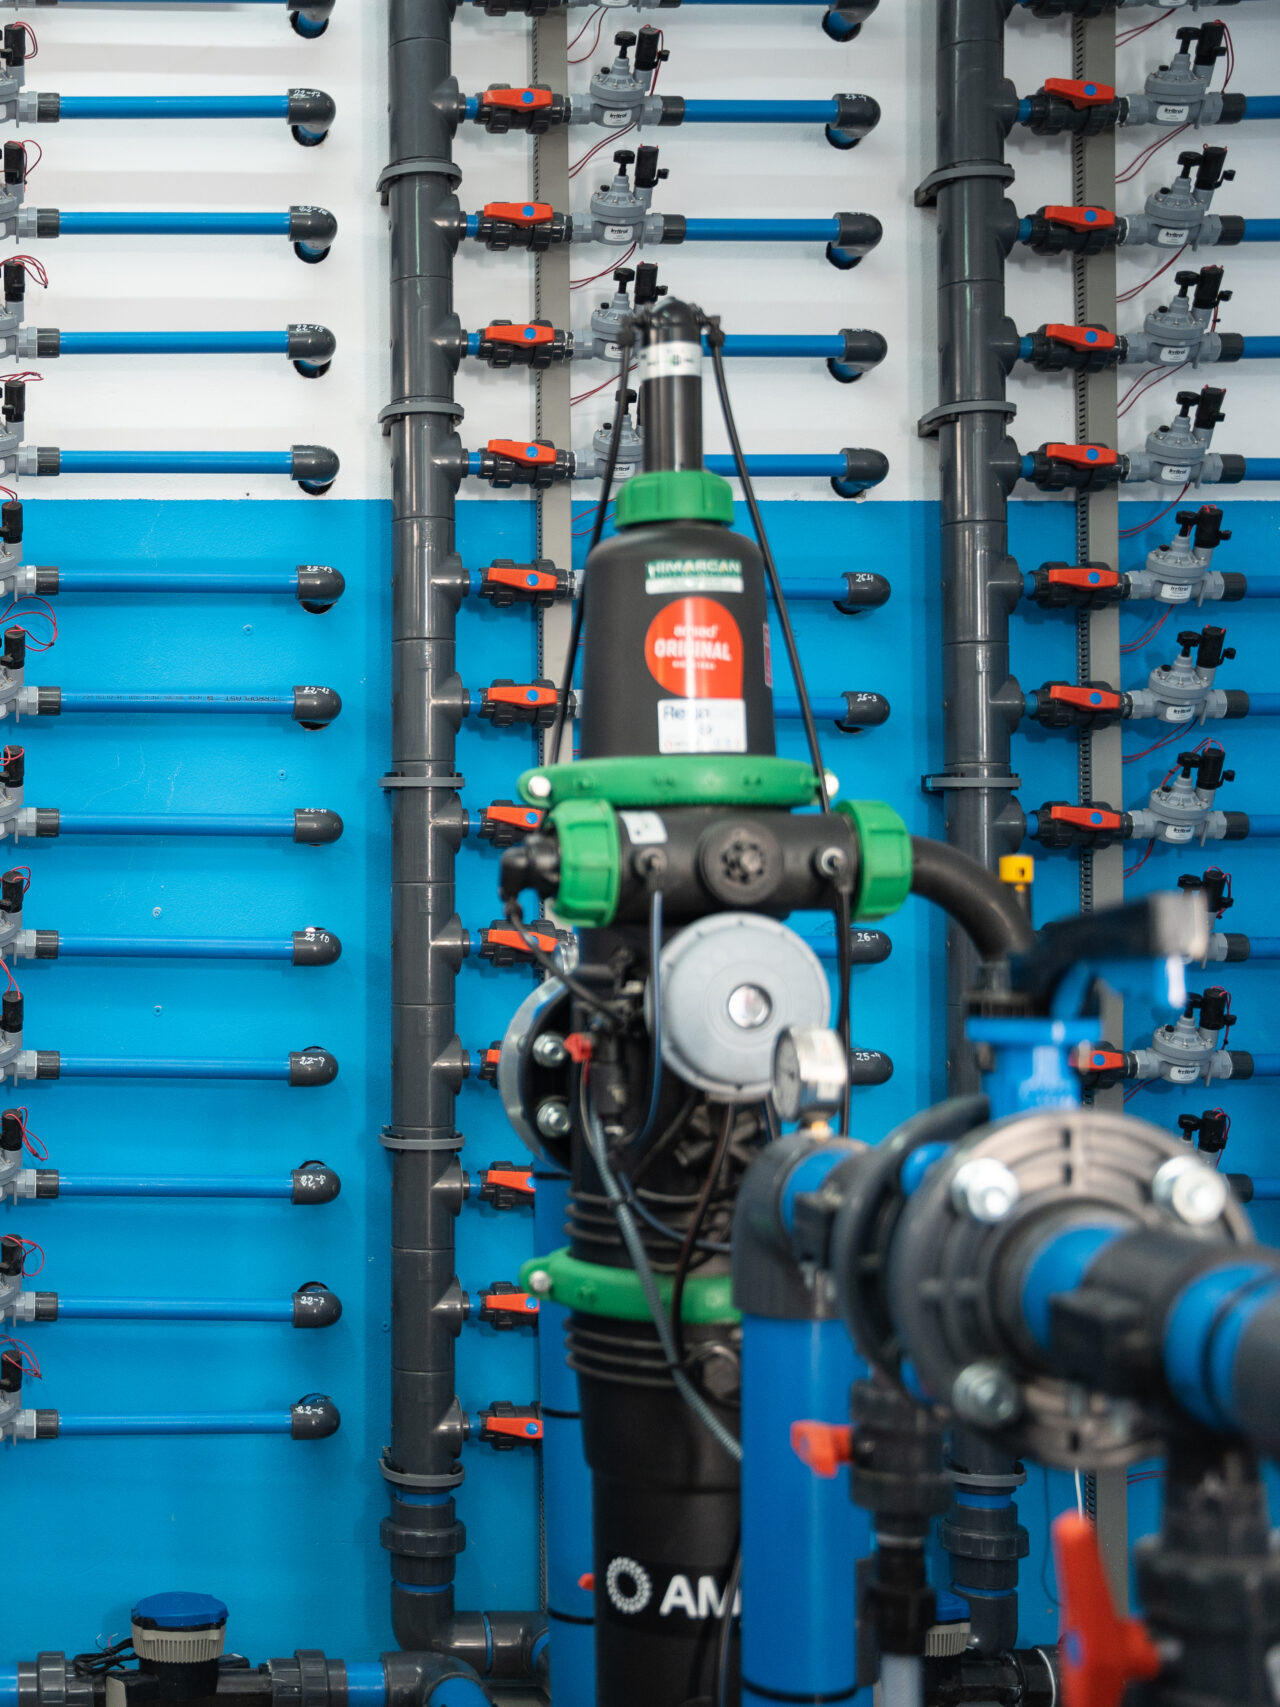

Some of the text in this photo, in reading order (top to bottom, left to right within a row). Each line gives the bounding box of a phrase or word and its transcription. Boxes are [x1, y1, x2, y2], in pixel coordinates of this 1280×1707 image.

[296, 324, 325, 333] 22-15
[646, 559, 741, 576] HIMARCAN
[654, 638, 732, 662] ORIGINAL
[856, 693, 878, 702] 26-3
[304, 932, 330, 943] 22-10
[857, 932, 879, 942] 26-1
[300, 1056, 325, 1067] 22-9
[300, 1175, 326, 1187] 22-8
[300, 1296, 325, 1306] 22-7
[297, 1406, 323, 1415] 22-6
